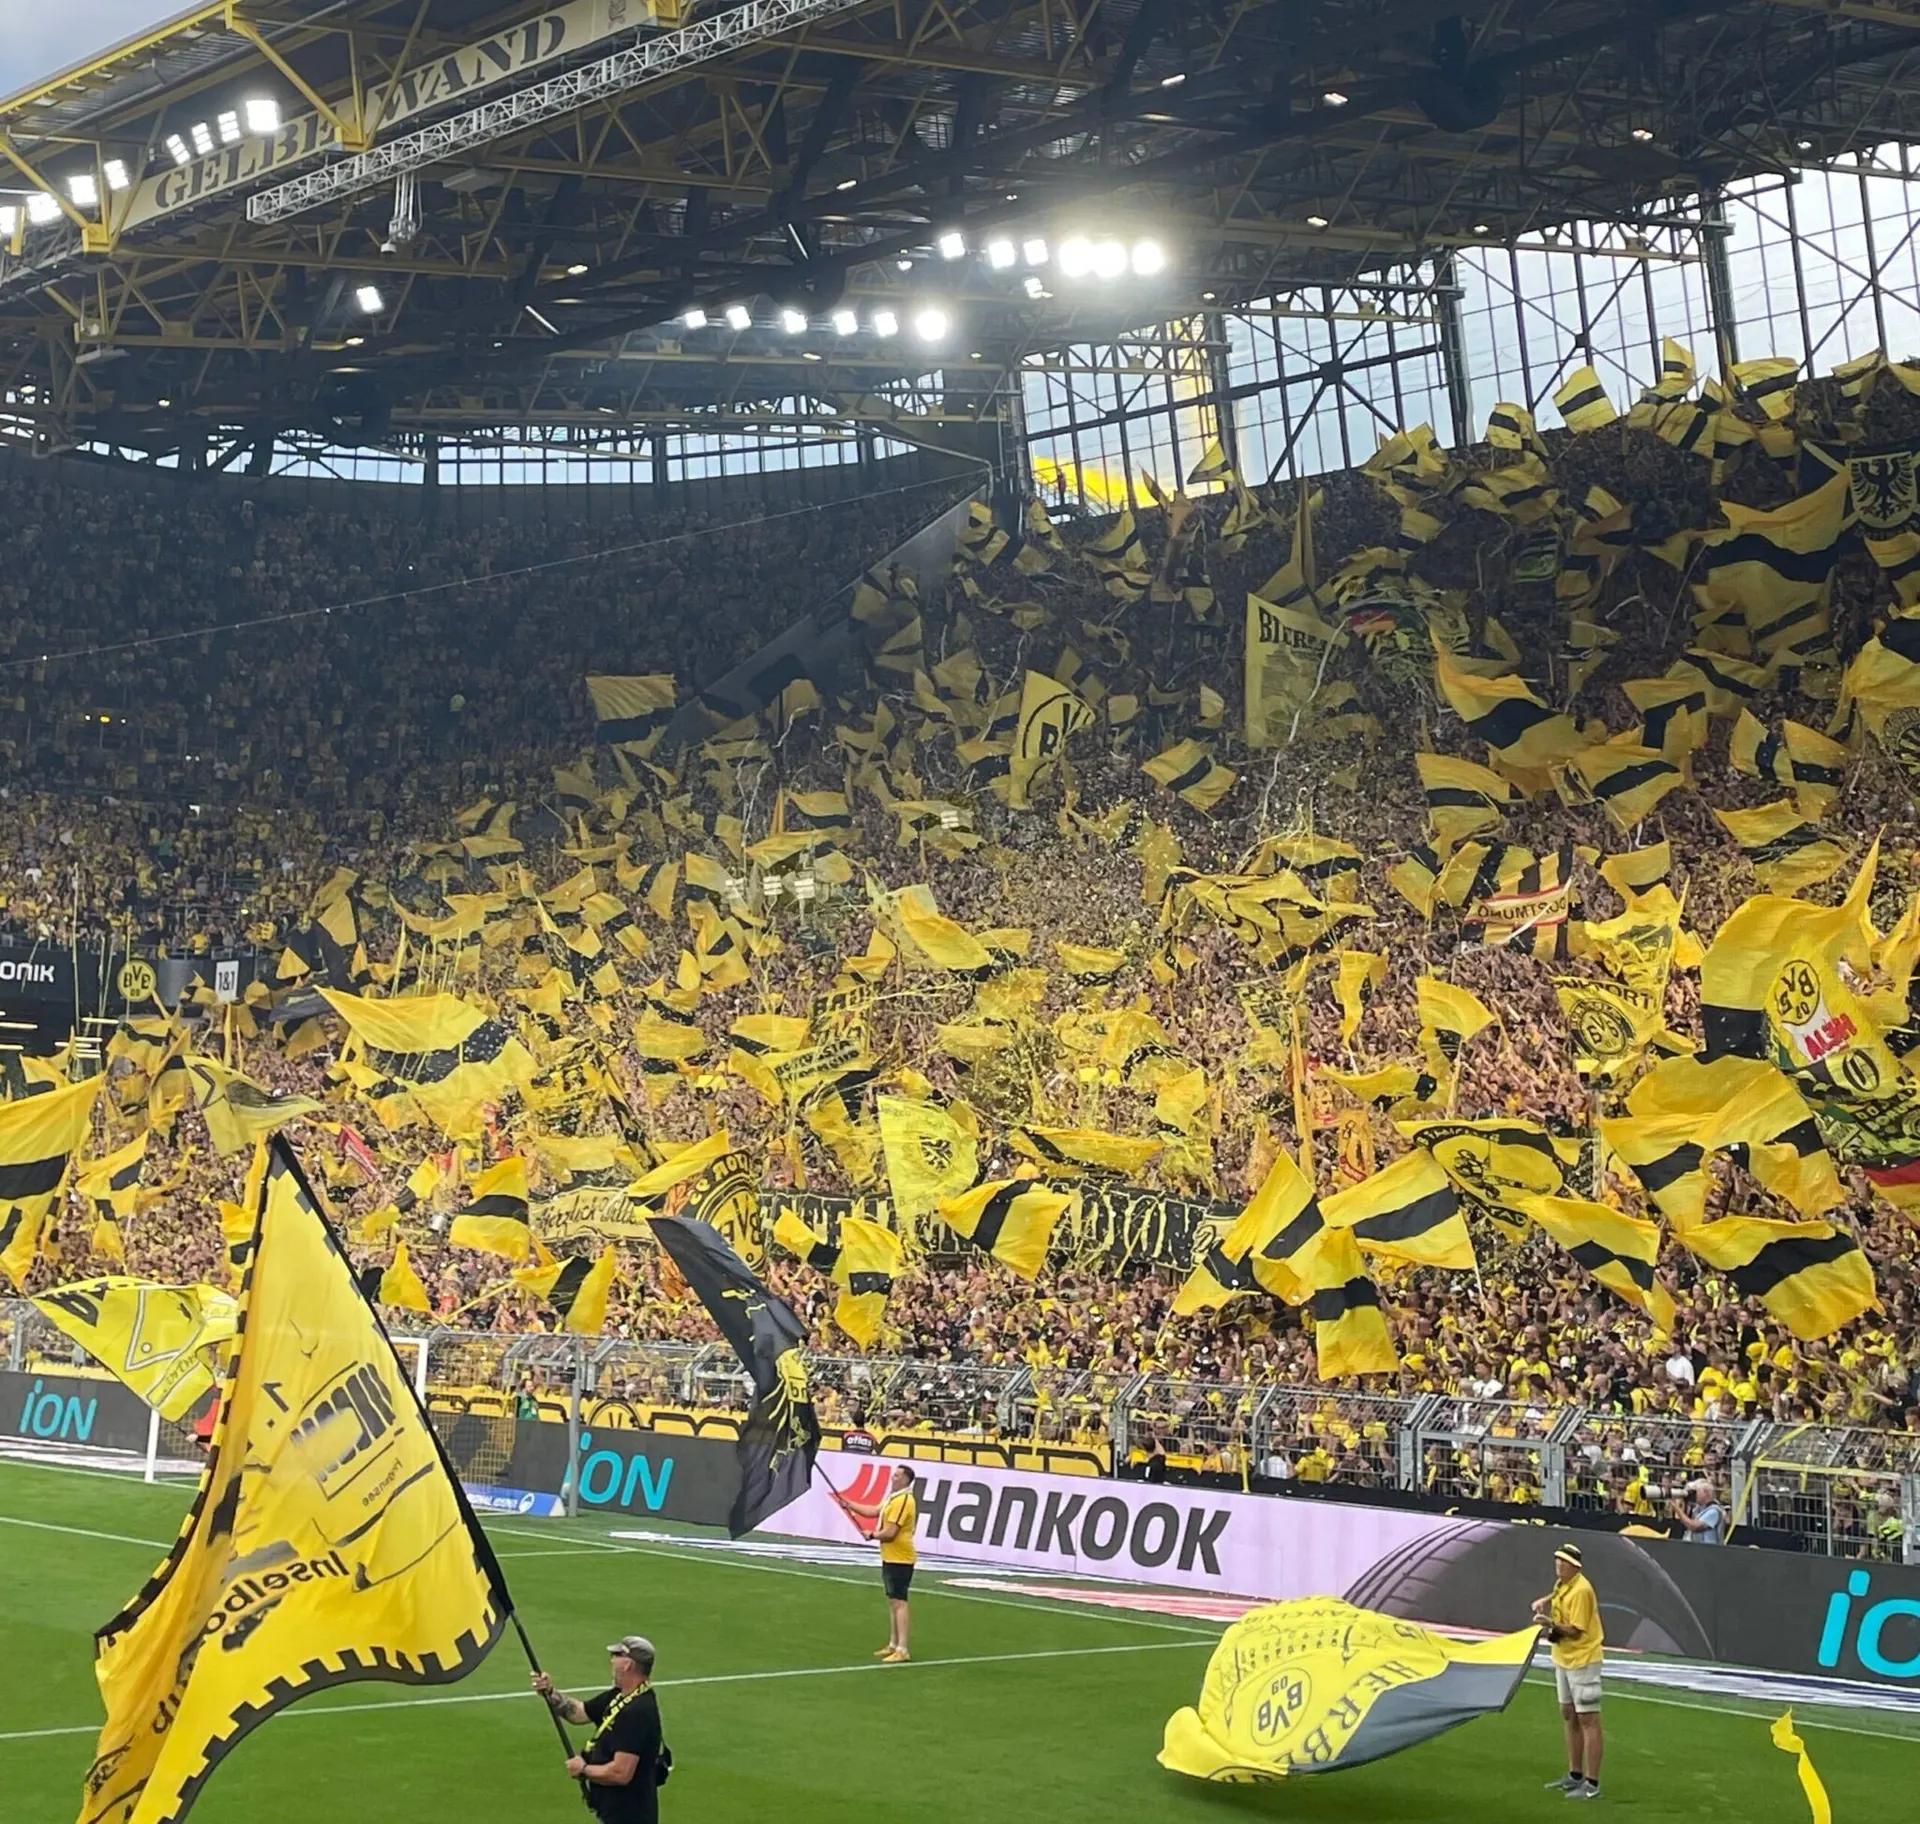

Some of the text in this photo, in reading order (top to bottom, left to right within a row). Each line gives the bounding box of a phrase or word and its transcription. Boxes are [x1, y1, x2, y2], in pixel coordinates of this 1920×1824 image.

[155, 15, 566, 208] GELBE WAND
[123, 965, 152, 989] BVB
[217, 970, 237, 991] 1&1
[19, 1379, 98, 1441] iON
[1271, 1675, 1289, 1694] 09
[1257, 1680, 1303, 1738] BVB
